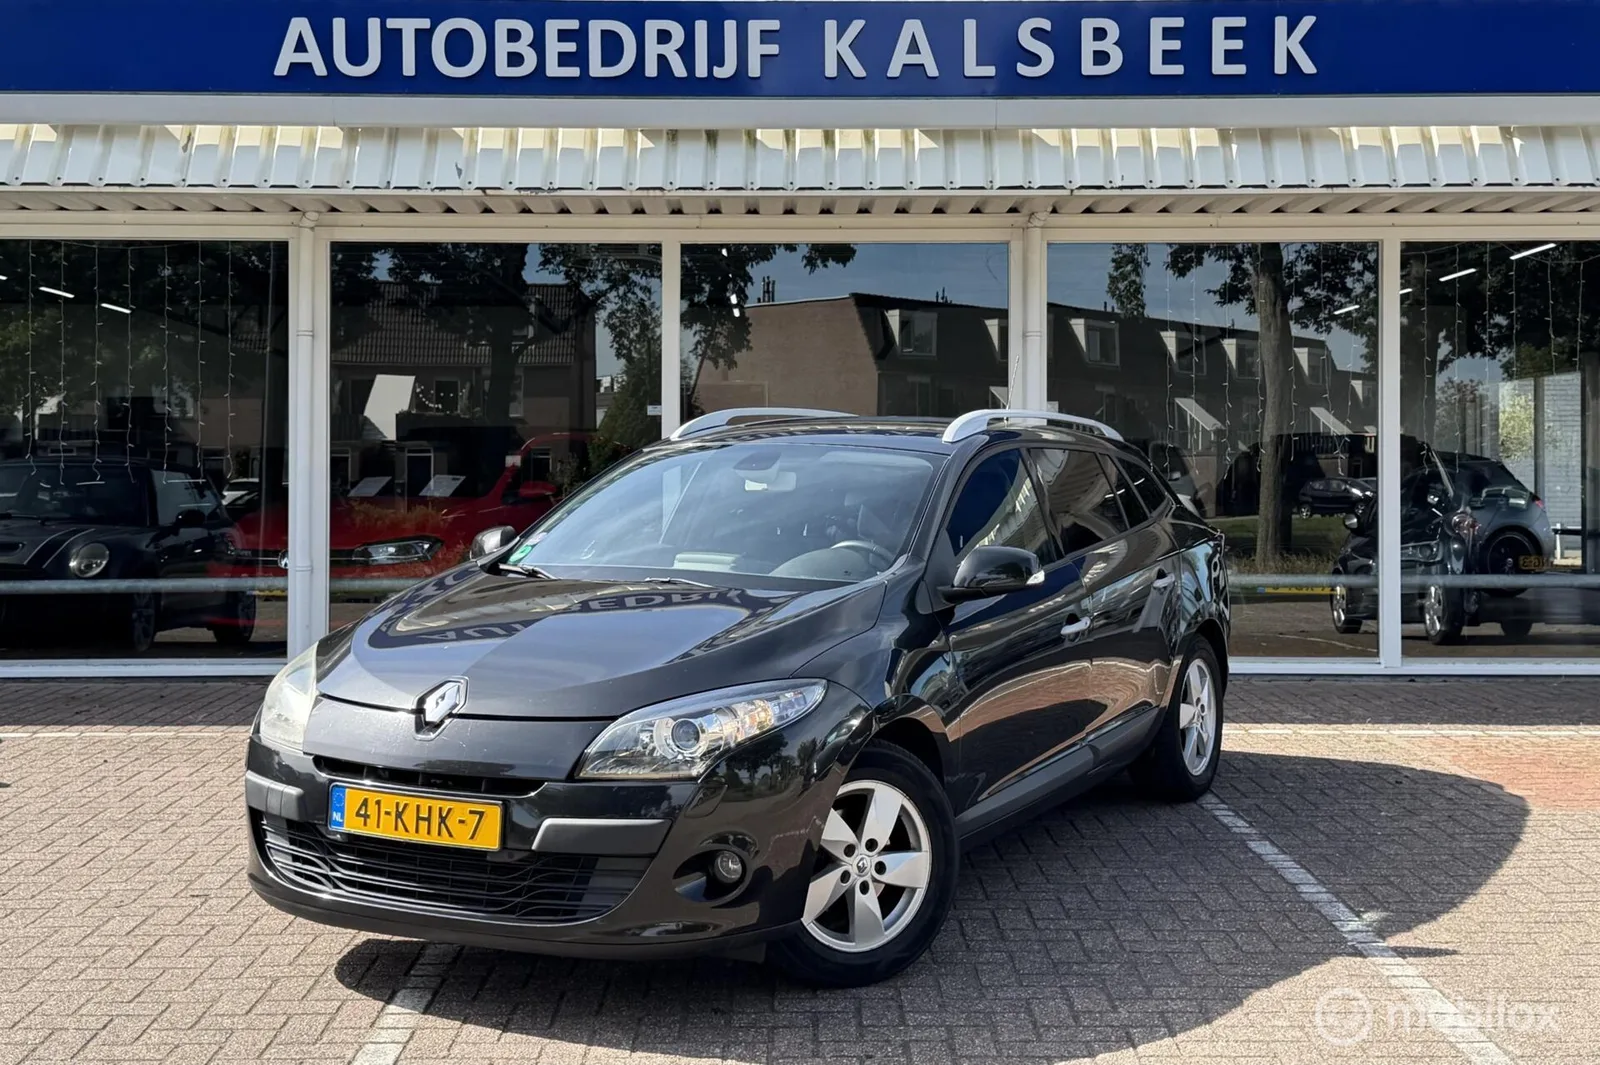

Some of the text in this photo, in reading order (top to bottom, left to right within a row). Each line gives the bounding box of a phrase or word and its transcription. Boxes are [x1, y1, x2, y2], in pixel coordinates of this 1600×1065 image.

[273, 15, 1318, 79] AUTOBEDRIJF KALSBEEK
[332, 812, 343, 823] NL
[355, 797, 486, 841] 41-KHK-7
